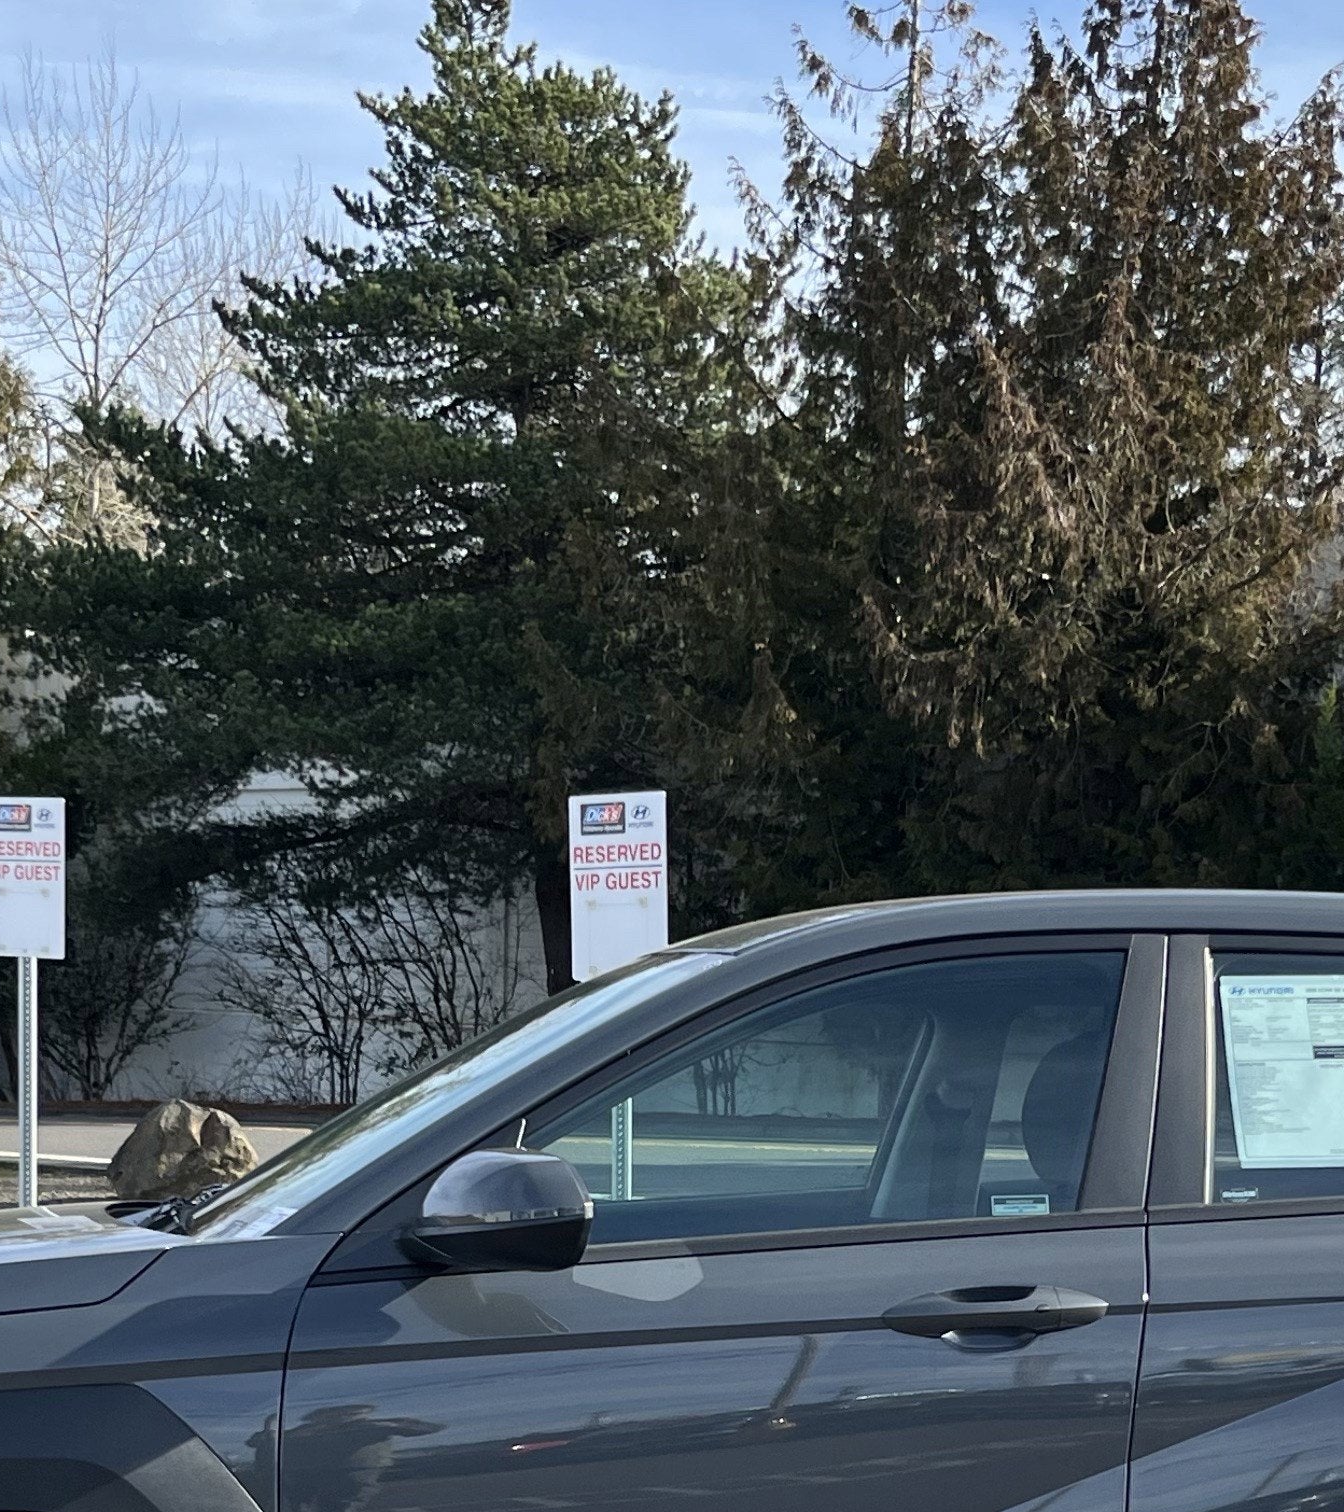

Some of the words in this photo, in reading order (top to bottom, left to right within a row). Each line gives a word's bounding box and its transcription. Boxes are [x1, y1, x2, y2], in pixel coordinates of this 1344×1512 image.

[573, 843, 662, 864] RESERVED
[14, 865, 61, 882] GUEST
[575, 873, 601, 892] VIP
[605, 870, 662, 891] GUEST
